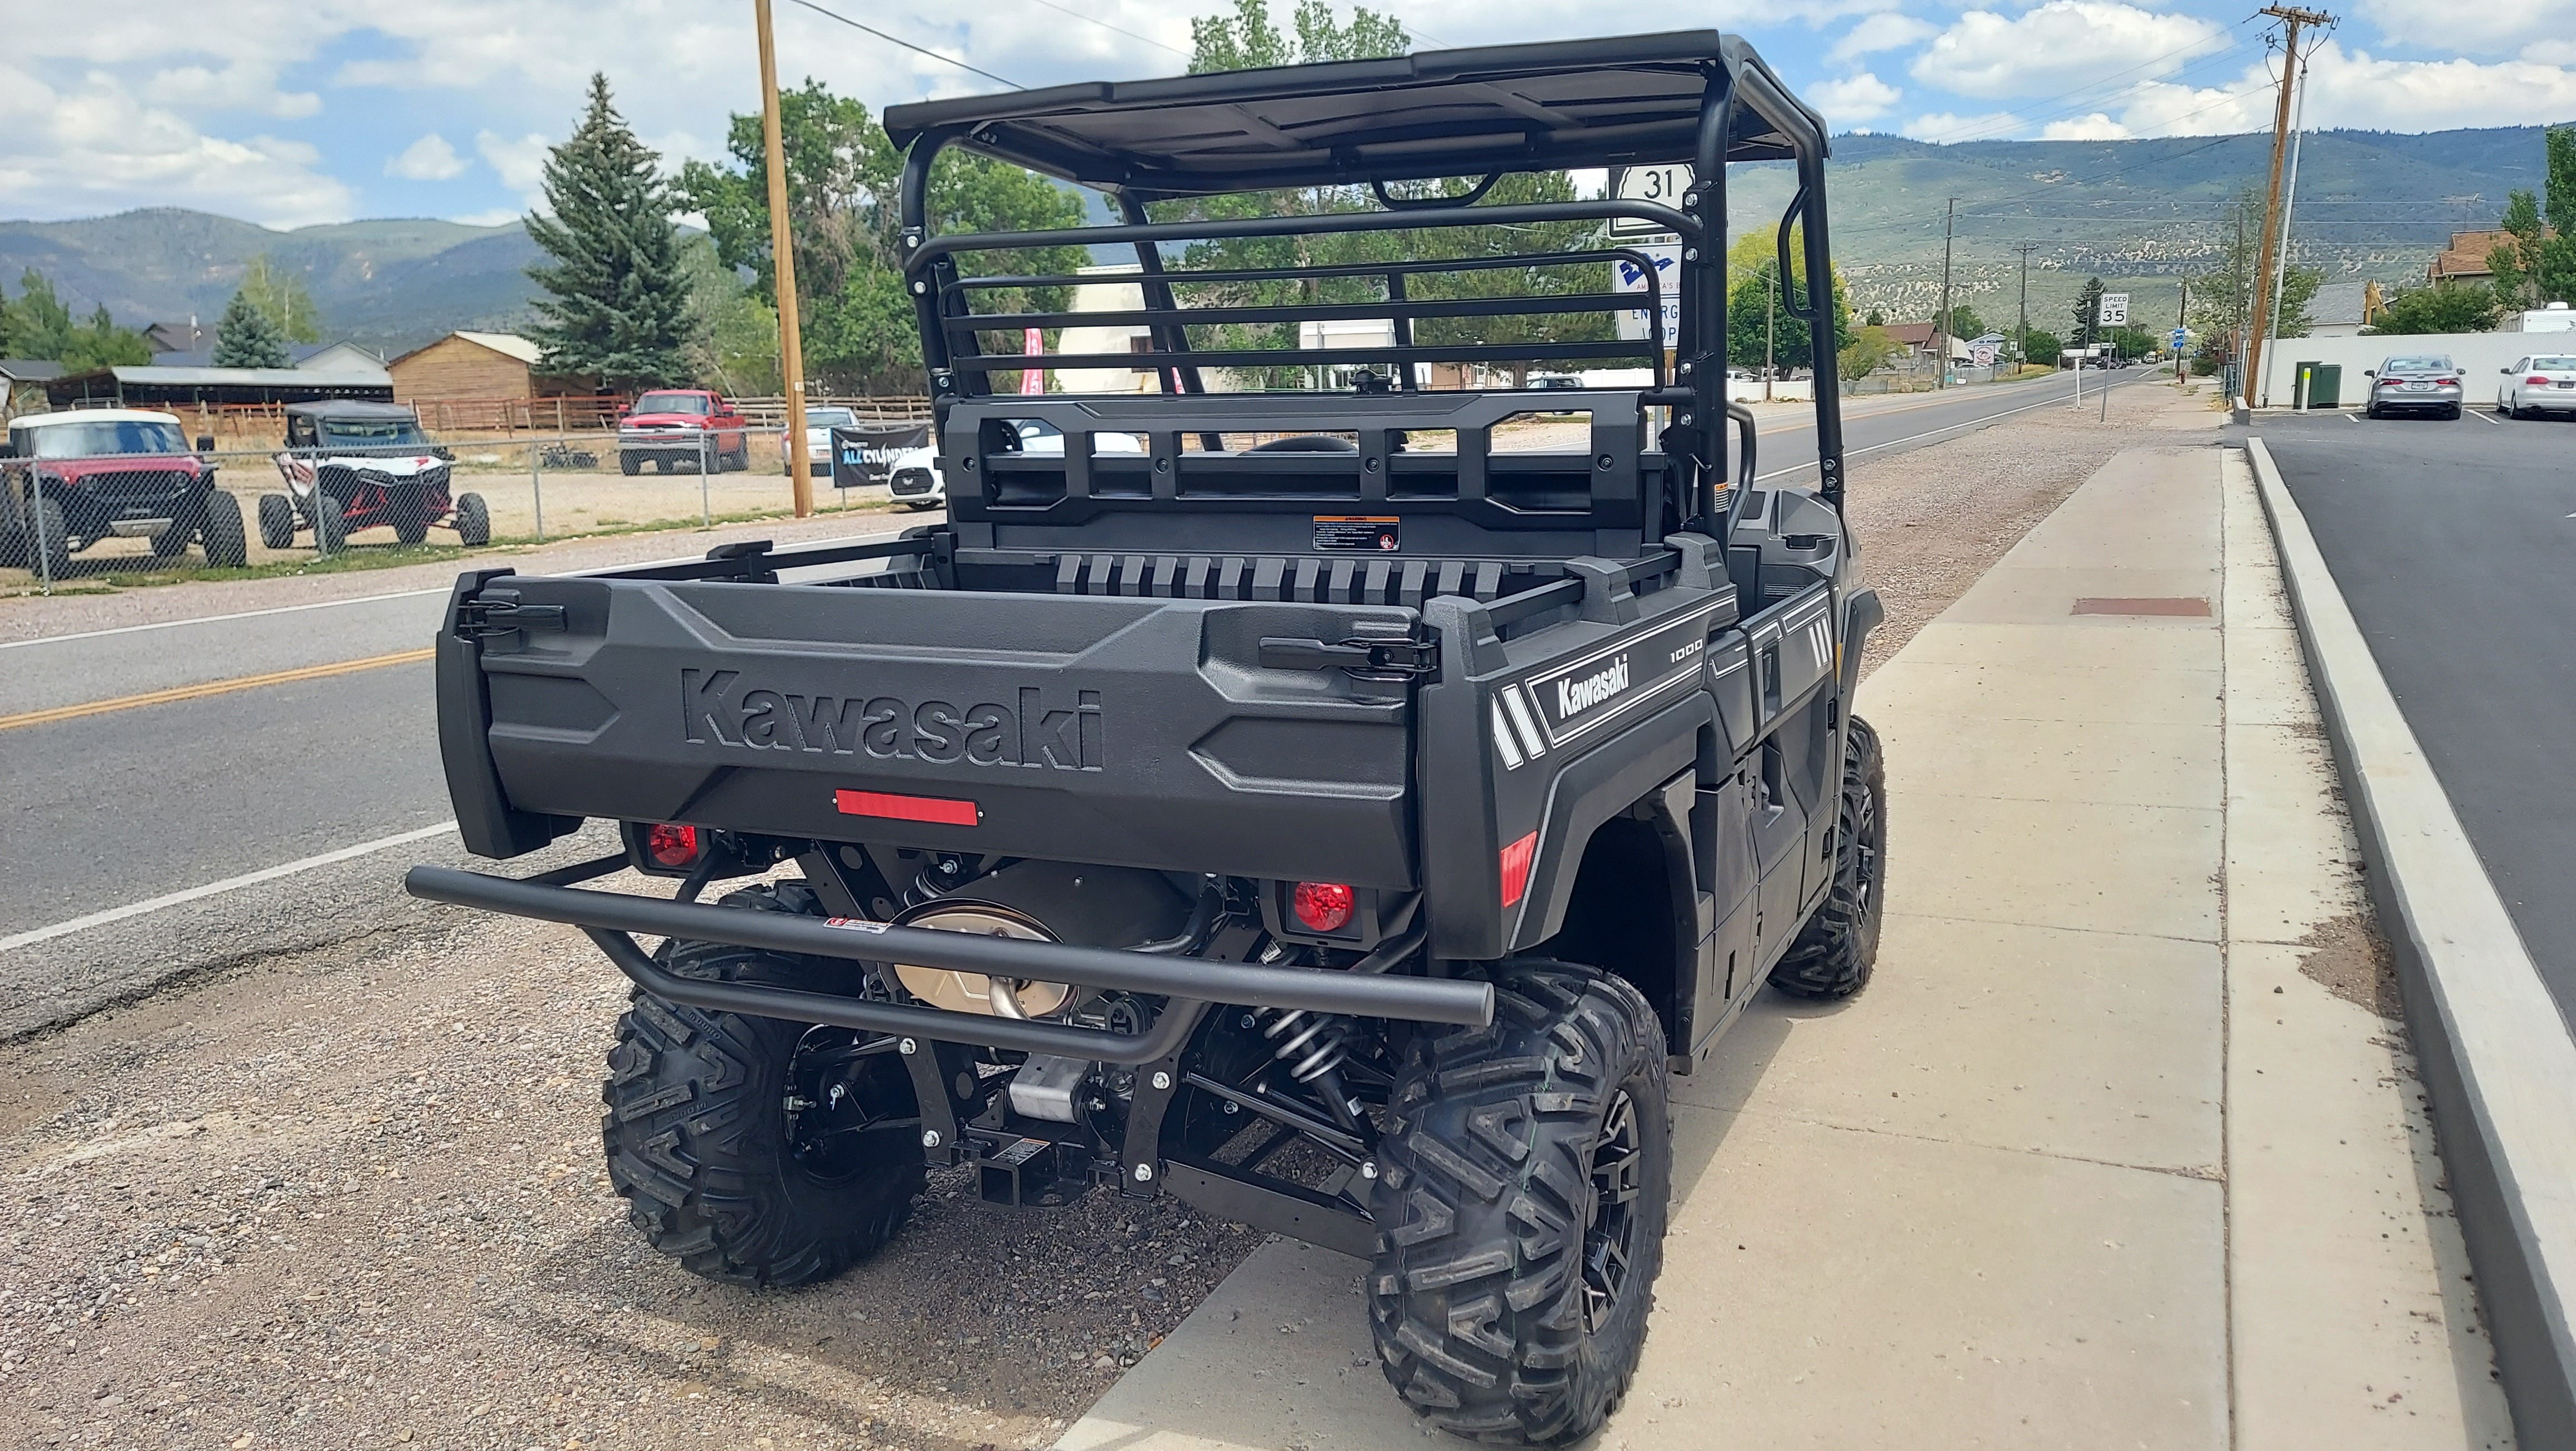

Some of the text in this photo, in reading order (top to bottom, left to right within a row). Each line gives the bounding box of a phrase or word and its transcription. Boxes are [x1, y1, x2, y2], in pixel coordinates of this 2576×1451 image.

[1644, 169, 1672, 199] 31
[2102, 310, 2125, 322] 35
[1670, 638, 1703, 663] 1000
[1558, 653, 1629, 719] Kawasaki
[681, 668, 1104, 772] Kawasaki
